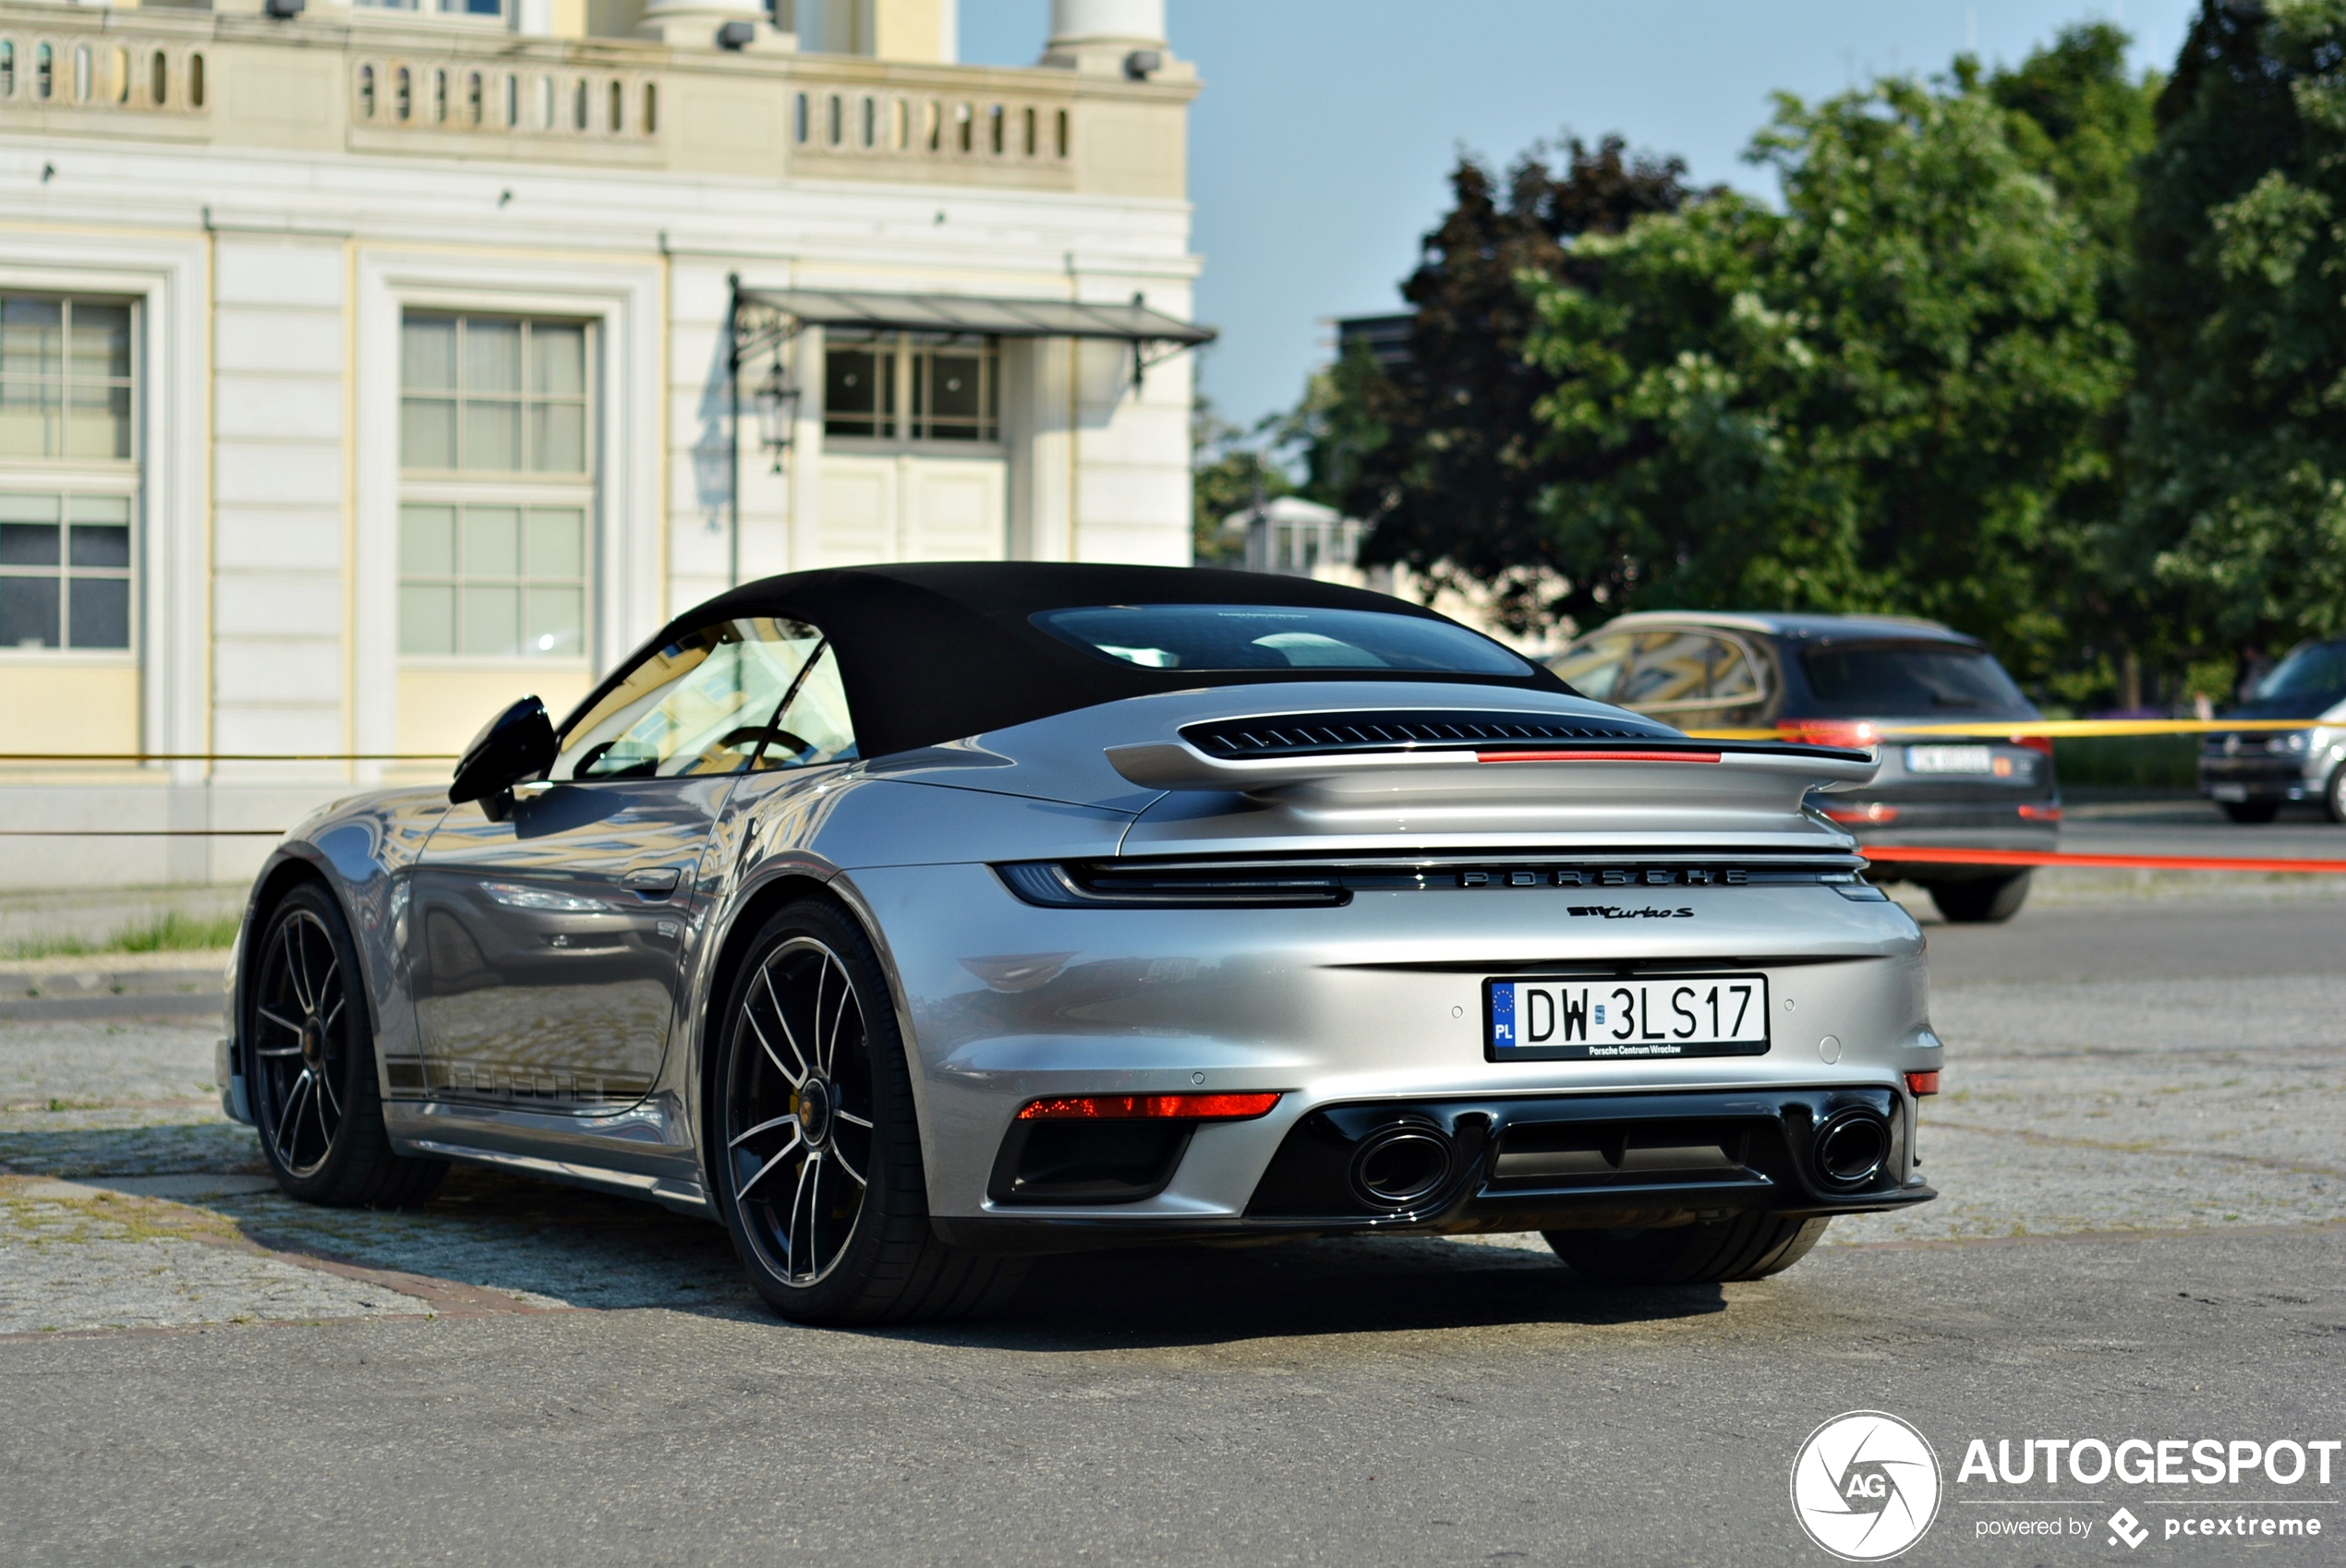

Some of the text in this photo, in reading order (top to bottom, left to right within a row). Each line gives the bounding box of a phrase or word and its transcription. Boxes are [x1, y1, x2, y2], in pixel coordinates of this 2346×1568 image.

[1463, 869, 1748, 887] PORSCHE
[1603, 906, 1673, 919] turbo
[1671, 907, 1695, 918] S
[1527, 984, 1752, 1043] DW 3LS17
[1495, 1024, 1513, 1039] PL
[1589, 1046, 1618, 1055] Porsche
[1618, 1045, 1650, 1055] Centrum
